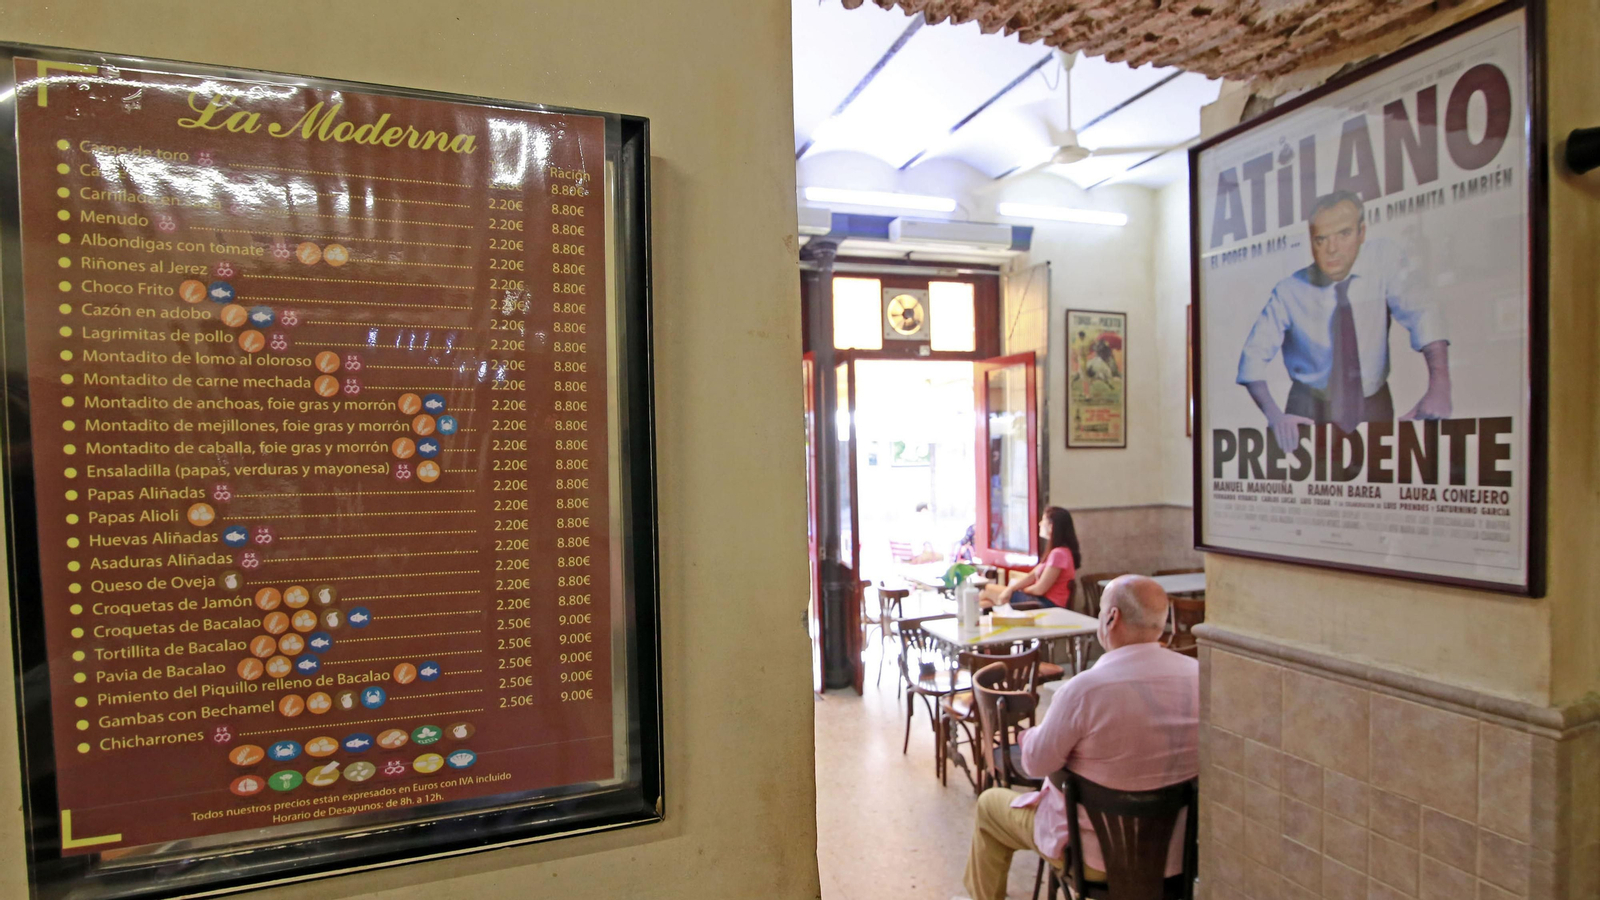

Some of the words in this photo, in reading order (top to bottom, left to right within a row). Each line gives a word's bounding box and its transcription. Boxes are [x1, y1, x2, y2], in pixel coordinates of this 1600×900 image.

[178, 90, 261, 134] La
[268, 101, 477, 155] Moderna
[157, 148, 189, 162] toro
[550, 166, 590, 182] Ración
[161, 194, 180, 206] en
[1368, 205, 1380, 225] LA
[1387, 188, 1445, 221] DINAMITA
[1451, 164, 1513, 203] TAMBIÉN
[81, 210, 148, 226] Menudo
[489, 218, 523, 231] 2.20€
[552, 223, 585, 236] 8.80€
[81, 233, 172, 252] Albondigas
[177, 242, 205, 252] con
[210, 243, 264, 256] tomate
[1222, 246, 1247, 265] PODER
[1252, 242, 1262, 258] DA
[1267, 235, 1286, 252] ALAS
[81, 256, 146, 272] Riñones
[150, 260, 163, 273] al
[168, 262, 207, 275] Jerez
[81, 280, 133, 294] Choco
[138, 283, 174, 296] Frito
[82, 303, 131, 316] Cazón
[136, 308, 156, 317] en
[160, 307, 211, 319] adobo
[83, 326, 166, 342] Lagrimitas
[170, 329, 190, 341] de
[194, 330, 234, 344] pollo
[491, 339, 525, 351] 2.20€
[554, 342, 586, 353] 8.80€
[83, 350, 167, 363] Montadito
[172, 352, 191, 364] de
[196, 352, 236, 365] lomo
[239, 354, 252, 365] al
[256, 354, 312, 366] oloroso
[84, 373, 168, 386] Montadito
[172, 374, 192, 386] de
[196, 378, 239, 387] carne
[243, 376, 311, 388] mechada
[85, 396, 169, 409] Montadito
[173, 397, 193, 409] de
[197, 397, 263, 411] anchoas,
[267, 397, 295, 410] foie
[299, 401, 329, 413] gras
[333, 402, 341, 413] y
[345, 399, 396, 410] morrón
[85, 419, 169, 431] Montadito
[174, 419, 193, 431] de
[198, 419, 279, 434] mejillones,
[282, 419, 310, 431] foie
[314, 423, 343, 435] gras
[347, 423, 355, 434] y
[359, 420, 409, 431] morrón
[492, 420, 526, 430] 2.20€
[555, 420, 587, 431] 8.80€
[86, 442, 170, 454] Montadito
[174, 441, 194, 454] de
[198, 441, 255, 455] caballa,
[259, 441, 287, 454] foie
[291, 444, 321, 456] gras
[325, 444, 333, 456] y
[337, 441, 388, 453] morrón
[1213, 416, 1512, 487] PRESIDENTE
[87, 464, 170, 478] Ensaladilla
[176, 464, 230, 479] (papas,
[234, 463, 298, 475] verduras
[302, 466, 310, 477] y
[314, 462, 389, 477] mayonesa)
[88, 488, 134, 503] Papas
[139, 486, 205, 499] Aliñadas
[1213, 481, 1244, 493] MANUEL
[1247, 481, 1293, 495] MANQUIÑA
[1308, 484, 1343, 497] RAMON
[1348, 485, 1381, 499] BAREA
[1399, 487, 1437, 502] LAURA
[1443, 489, 1509, 505] CONEJERO
[494, 500, 528, 511] 2.20€
[557, 498, 589, 509] 8.80€
[1400, 503, 1429, 512] PRENDES
[89, 511, 135, 526] Papas
[139, 509, 179, 522] Alioli
[89, 534, 148, 547] Huevas
[152, 531, 218, 544] Aliñadas
[90, 555, 163, 570] Asaduras
[167, 552, 233, 566] Aliñadas
[91, 580, 143, 593] Queso
[147, 577, 167, 590] de
[171, 576, 215, 590] Oveja
[496, 579, 530, 590] 2.20€
[558, 575, 590, 587] 8.80€
[92, 601, 174, 616] Croquetas
[178, 598, 198, 610] de
[202, 595, 252, 609] Jamón
[94, 623, 175, 638] Croquetas
[179, 620, 199, 632] de
[203, 617, 261, 631] Bacalao
[94, 645, 160, 660] Tortillita
[164, 643, 184, 655] de
[188, 639, 247, 654] Bacalao
[498, 637, 531, 650] 2.50€
[559, 632, 591, 645] 9.00€
[96, 669, 138, 683] Pavia
[142, 666, 162, 679] de
[167, 662, 226, 678] Bacalao
[98, 690, 169, 706] Pimiento
[173, 685, 197, 699] del
[202, 681, 258, 697] Piquillo
[262, 679, 312, 691] relleno
[316, 675, 334, 686] de
[338, 670, 390, 684] Bacalao
[500, 695, 533, 708] 2.50€
[561, 689, 593, 702] 9.00€
[99, 712, 164, 728] Gambas
[168, 711, 197, 721] con
[201, 700, 274, 718] Bechamel
[100, 731, 204, 751] Chicharrones
[191, 810, 224, 821] Todos
[226, 804, 271, 816] nuestros
[274, 799, 310, 815] precios
[313, 795, 339, 805] están
[342, 786, 397, 804] expresados
[413, 783, 438, 792] Euros
[440, 780, 457, 788] con
[459, 776, 474, 785] IVA
[476, 772, 511, 783] incluido
[273, 813, 310, 822] Horario
[314, 809, 326, 817] de
[329, 802, 384, 817] Desayunos:
[386, 799, 398, 807] de
[400, 797, 414, 806] 8h.
[425, 793, 444, 802] 12h.
